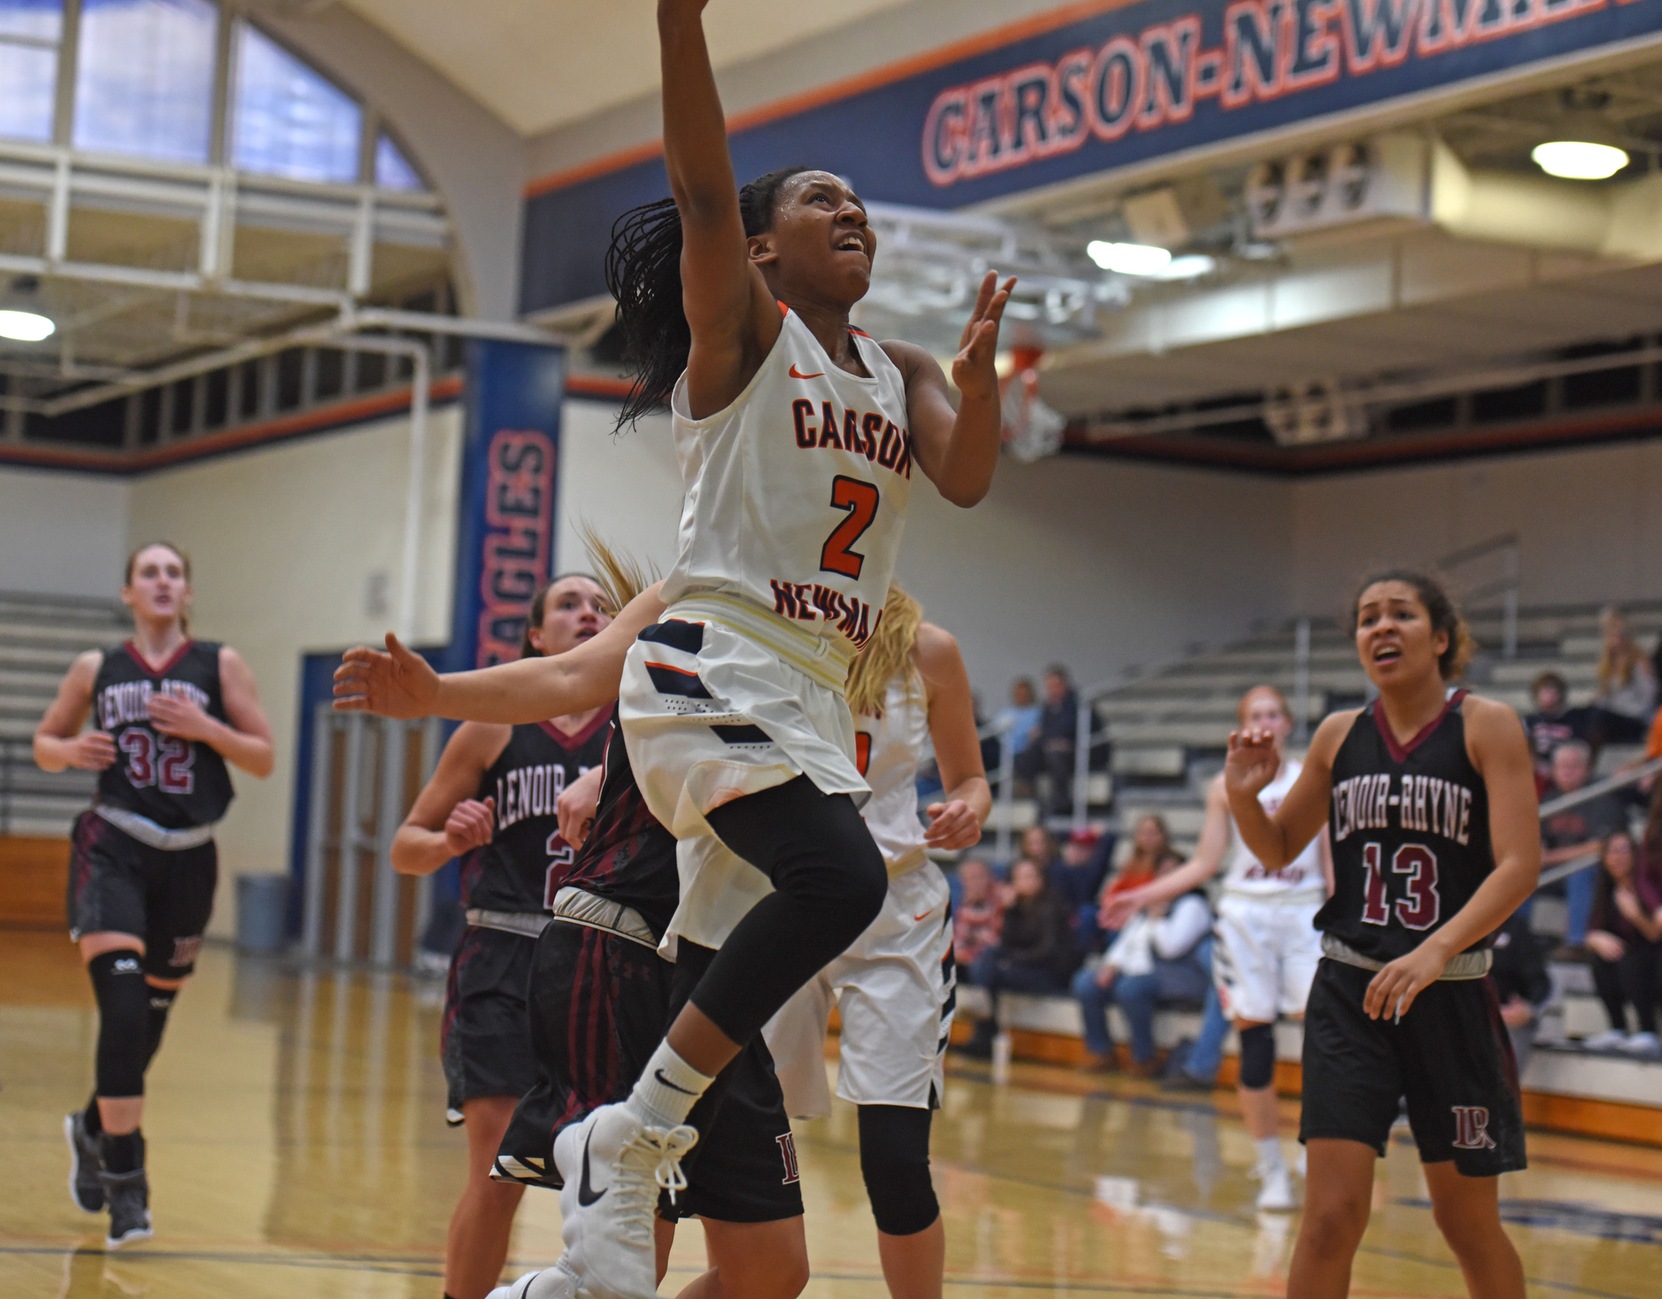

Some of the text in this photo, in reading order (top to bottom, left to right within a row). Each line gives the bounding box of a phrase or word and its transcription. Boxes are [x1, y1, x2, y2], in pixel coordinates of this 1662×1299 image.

[791, 398, 911, 480] CARSON
[477, 429, 557, 668] AGLES
[819, 474, 880, 581] 2
[770, 578, 883, 653] NEWMA
[118, 727, 196, 795] 32
[1332, 773, 1472, 846] LENOIR-RHYNE
[1361, 841, 1440, 931] 13
